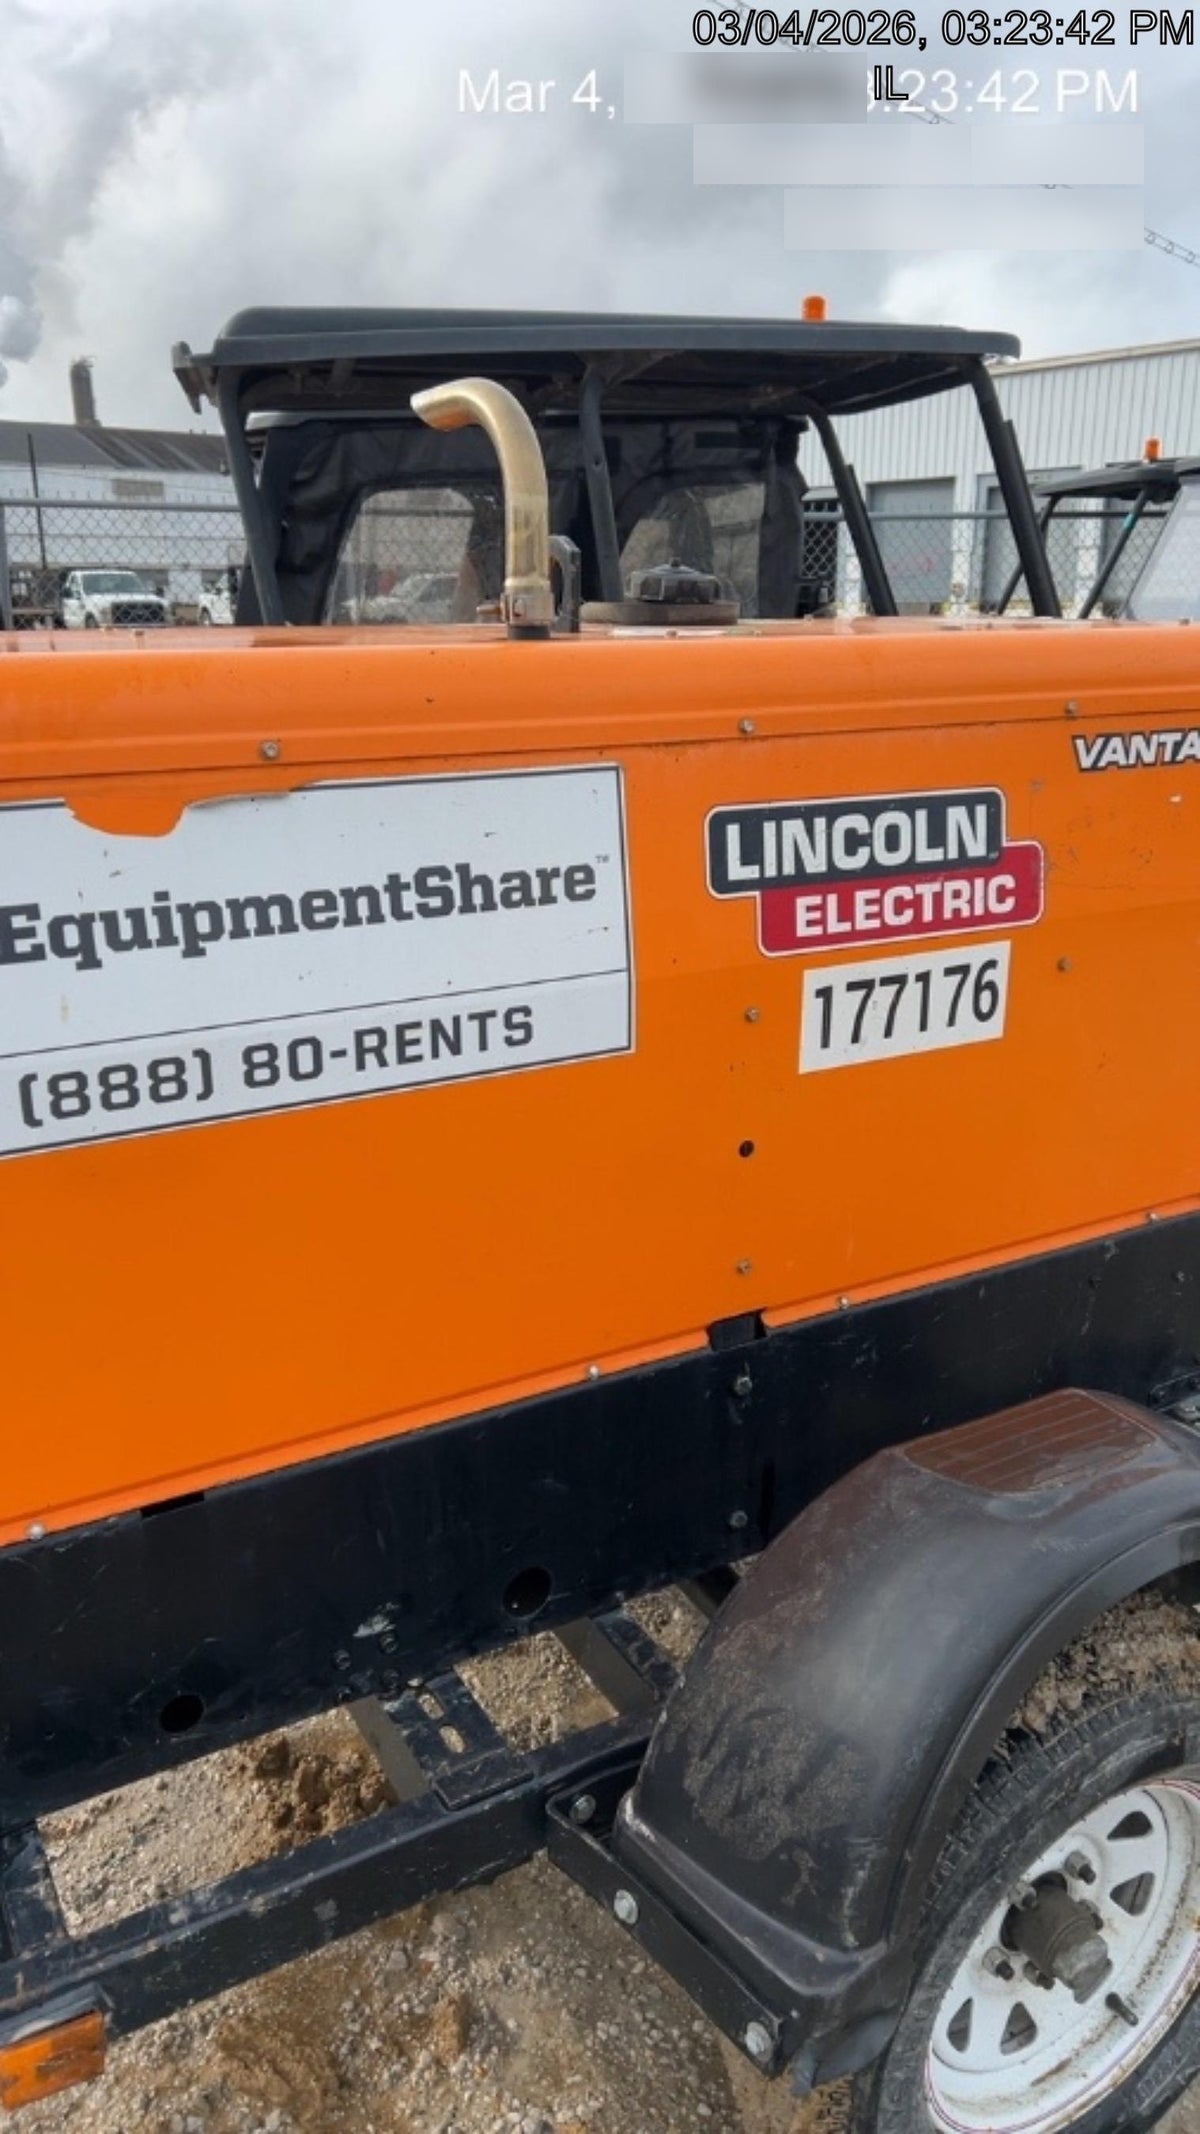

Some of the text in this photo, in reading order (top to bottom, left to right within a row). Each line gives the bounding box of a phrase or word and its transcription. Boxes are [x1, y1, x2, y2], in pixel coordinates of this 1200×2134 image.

[725, 804, 988, 882] LINCOLN
[0, 863, 597, 970] EquipmentShare
[795, 874, 1016, 938] ELECTRIC
[815, 959, 1000, 1049] 177176
[18, 1005, 534, 1128] (888) 80-RENTS
